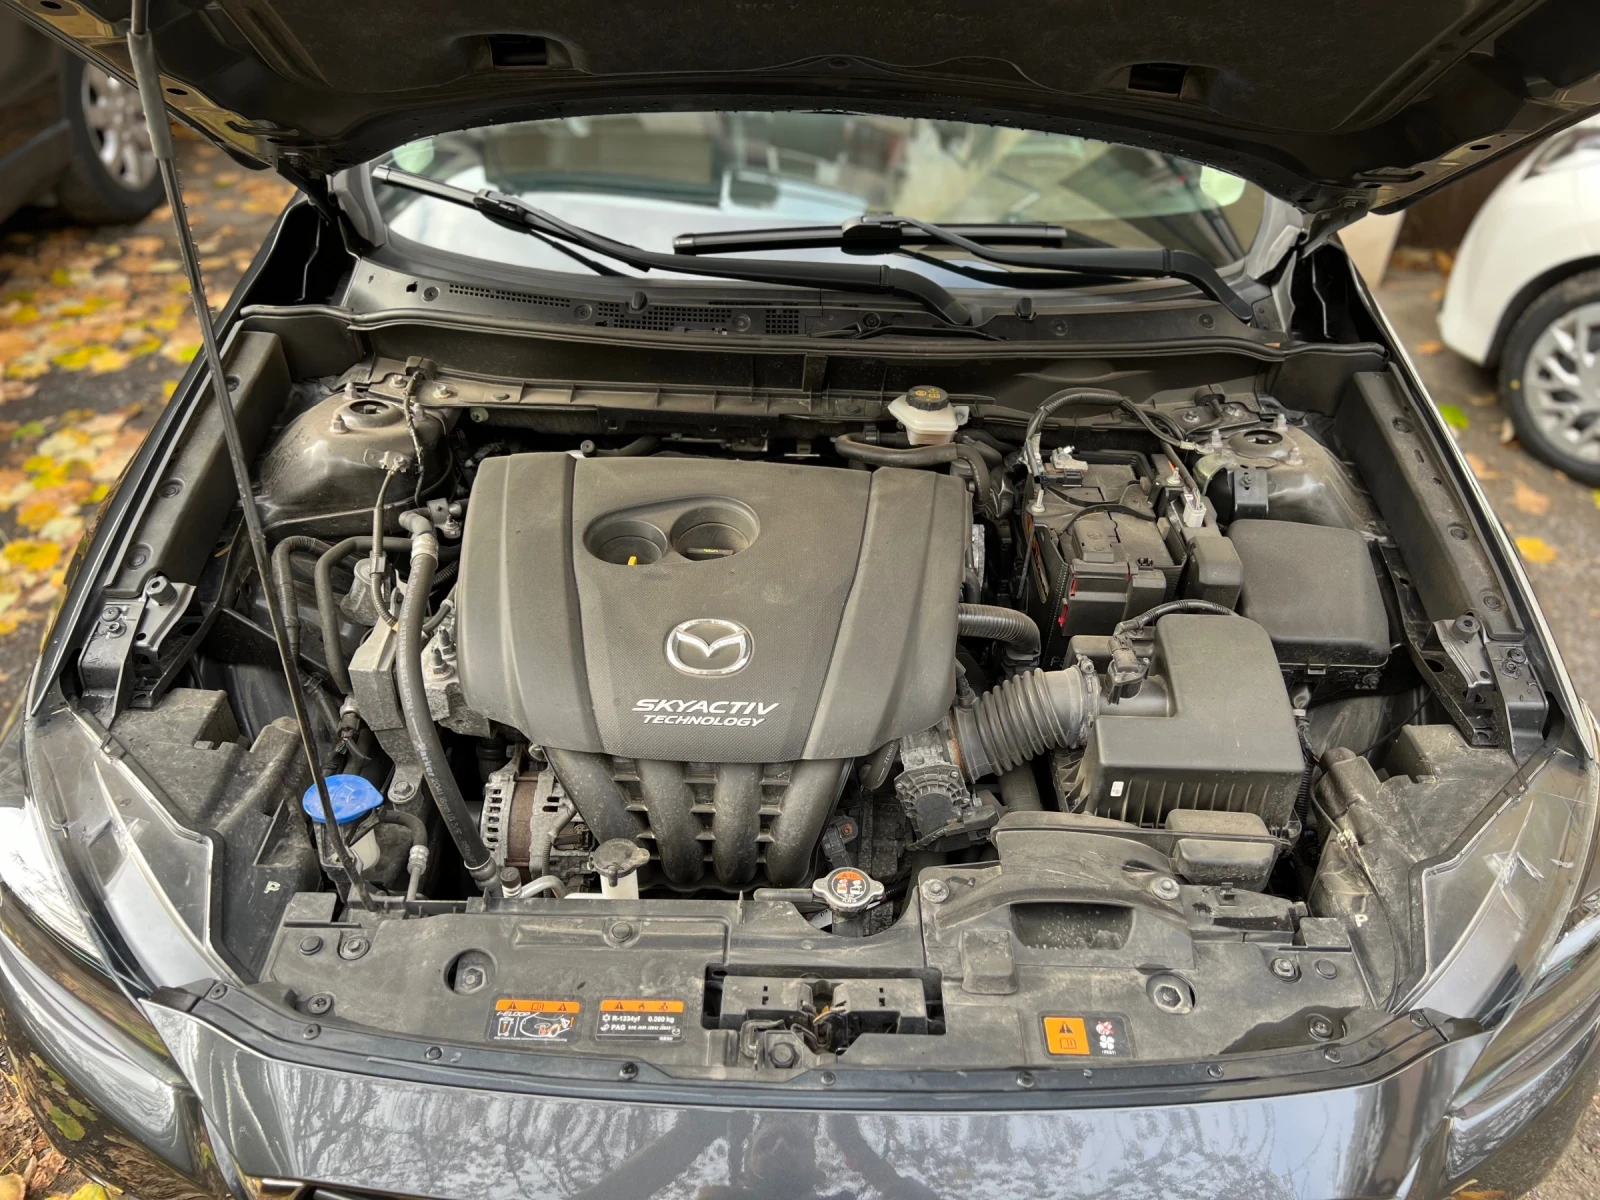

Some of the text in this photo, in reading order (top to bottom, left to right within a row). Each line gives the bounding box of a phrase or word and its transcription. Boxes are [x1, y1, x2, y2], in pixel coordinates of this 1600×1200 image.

[632, 699, 780, 715] SKYACTIV
[642, 714, 765, 727] TECHNOLOGY
[263, 880, 281, 894] P
[1354, 914, 1369, 928] P
[611, 1015, 641, 1023] R-1234yf
[666, 1016, 675, 1024] kg
